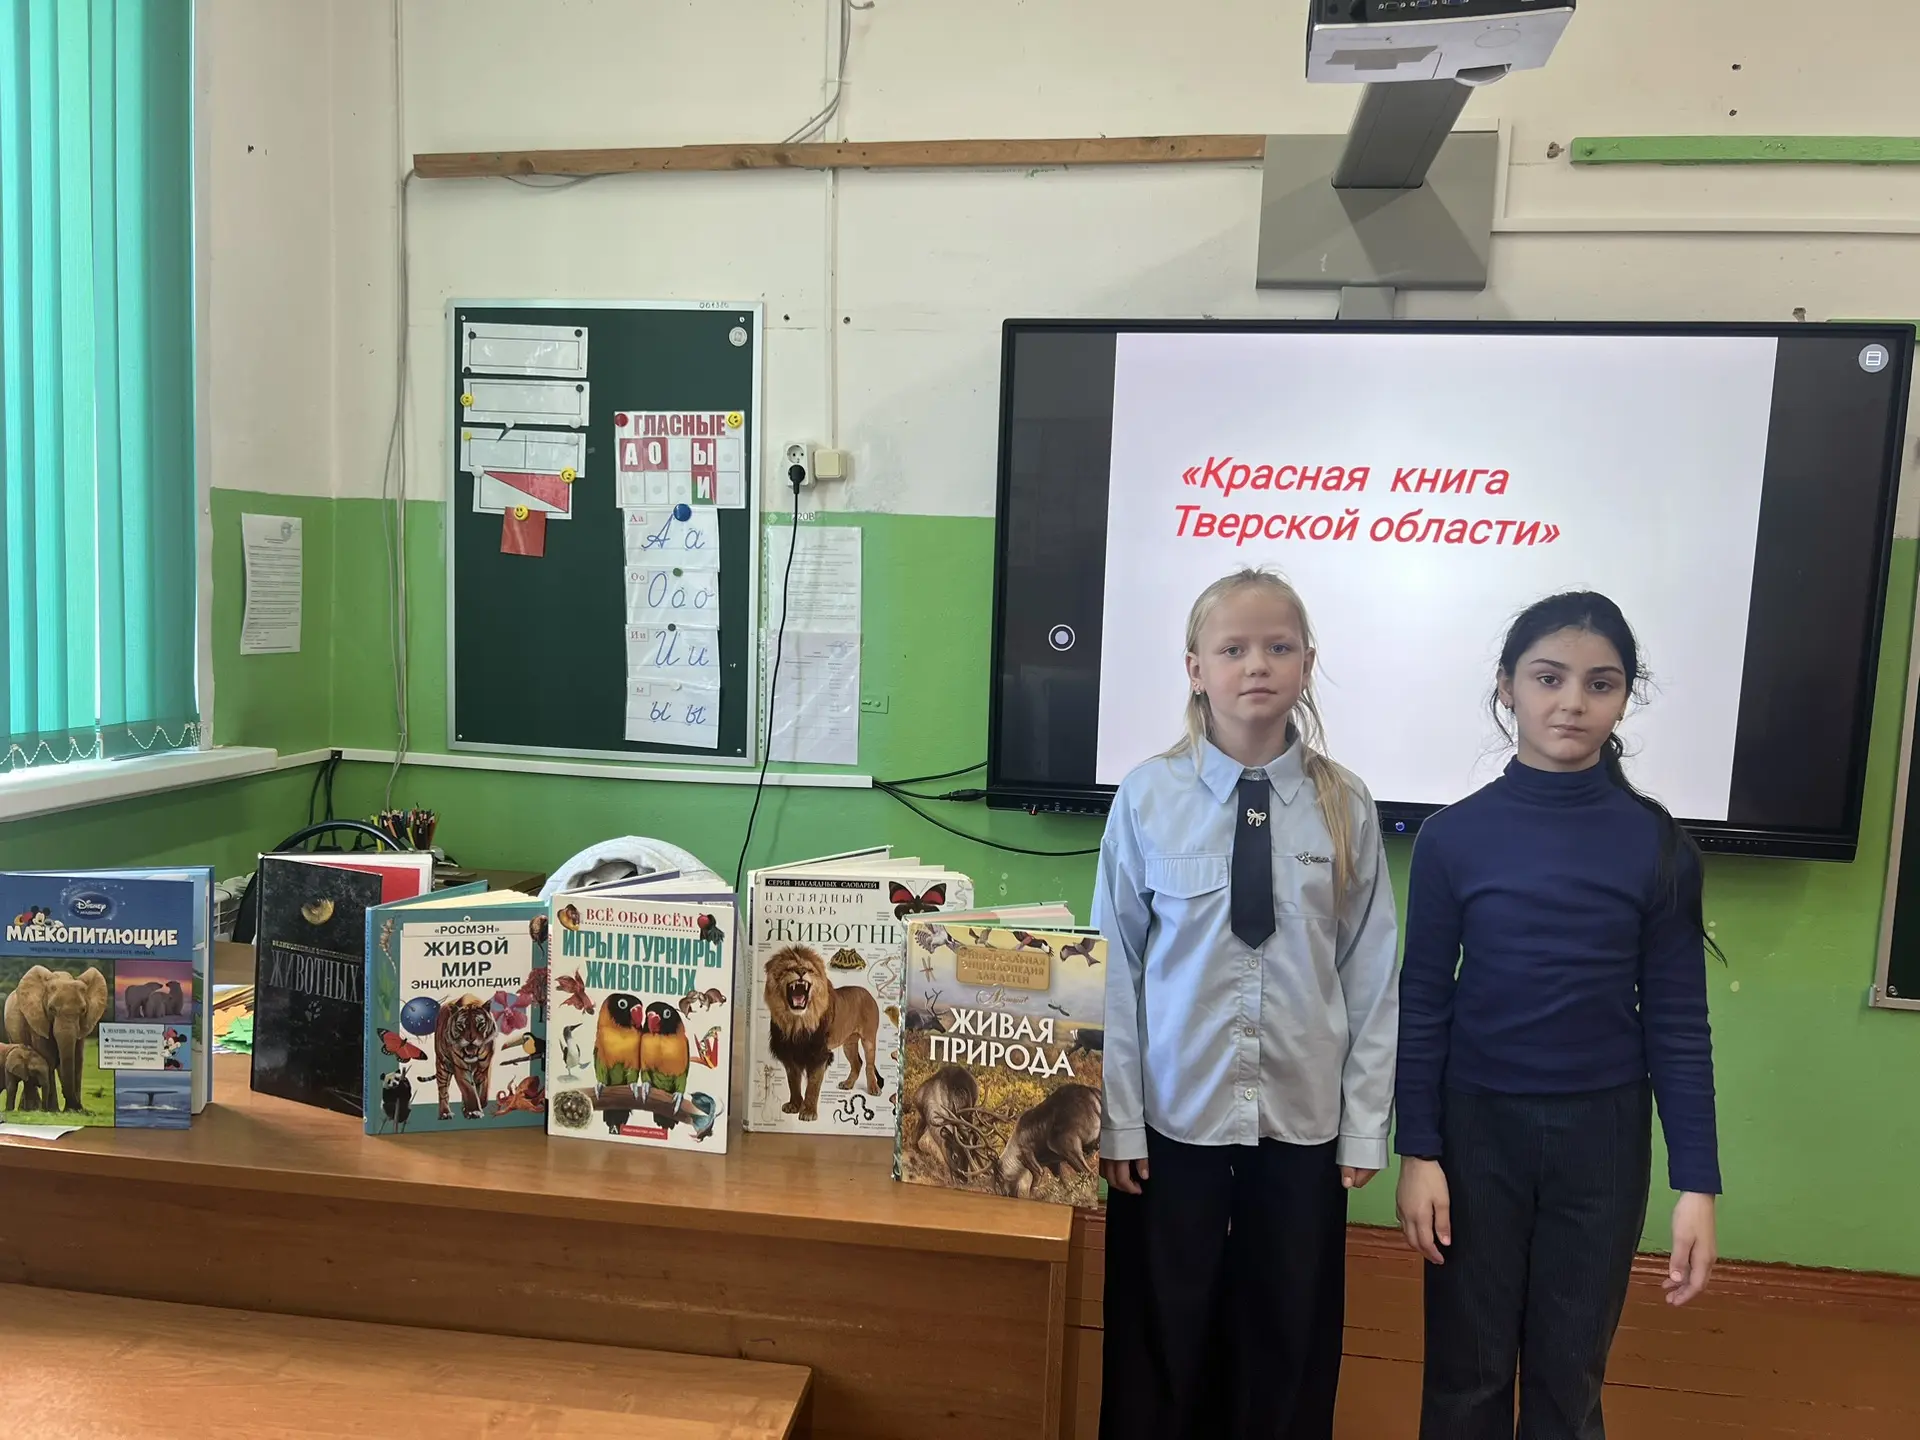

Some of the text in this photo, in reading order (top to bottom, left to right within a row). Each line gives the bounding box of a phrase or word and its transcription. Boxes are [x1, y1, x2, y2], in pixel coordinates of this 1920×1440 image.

[634, 415, 726, 436] ГЛАСНЫЕ
[625, 441, 713, 465] А О Ы
[697, 476, 710, 498] И
[1181, 456, 1510, 498] «Красная книга
[1173, 504, 1561, 547] Тверской области»
[794, 880, 837, 889] НАГЛЯДНЫХ
[840, 881, 878, 890] СЛОВАРЕЙ
[75, 899, 107, 912] Disney
[765, 892, 864, 904] НАГЛЯДНЫЙ
[586, 908, 694, 929] ВСЁ ОБО ВСЁМ
[764, 905, 837, 916] СЛОВАРЬ
[6, 924, 178, 949] МЛЕКОПИТАЮЩИЕ
[434, 924, 500, 935] «РОСМЭН»
[424, 937, 509, 957] ЖИВОЙ
[562, 929, 723, 969] ИГРЫ И ТУРНИРЫ
[269, 949, 360, 1004] ЖИВОТНЫХ
[442, 961, 492, 977] МИР
[585, 960, 697, 996] ЖИВОТНЫХ
[411, 977, 521, 990] ЭНЦИКЛОПЕДИЯ
[949, 1007, 1054, 1044] ЖИВАЯ
[929, 1035, 1075, 1078] ПРИРОДА
